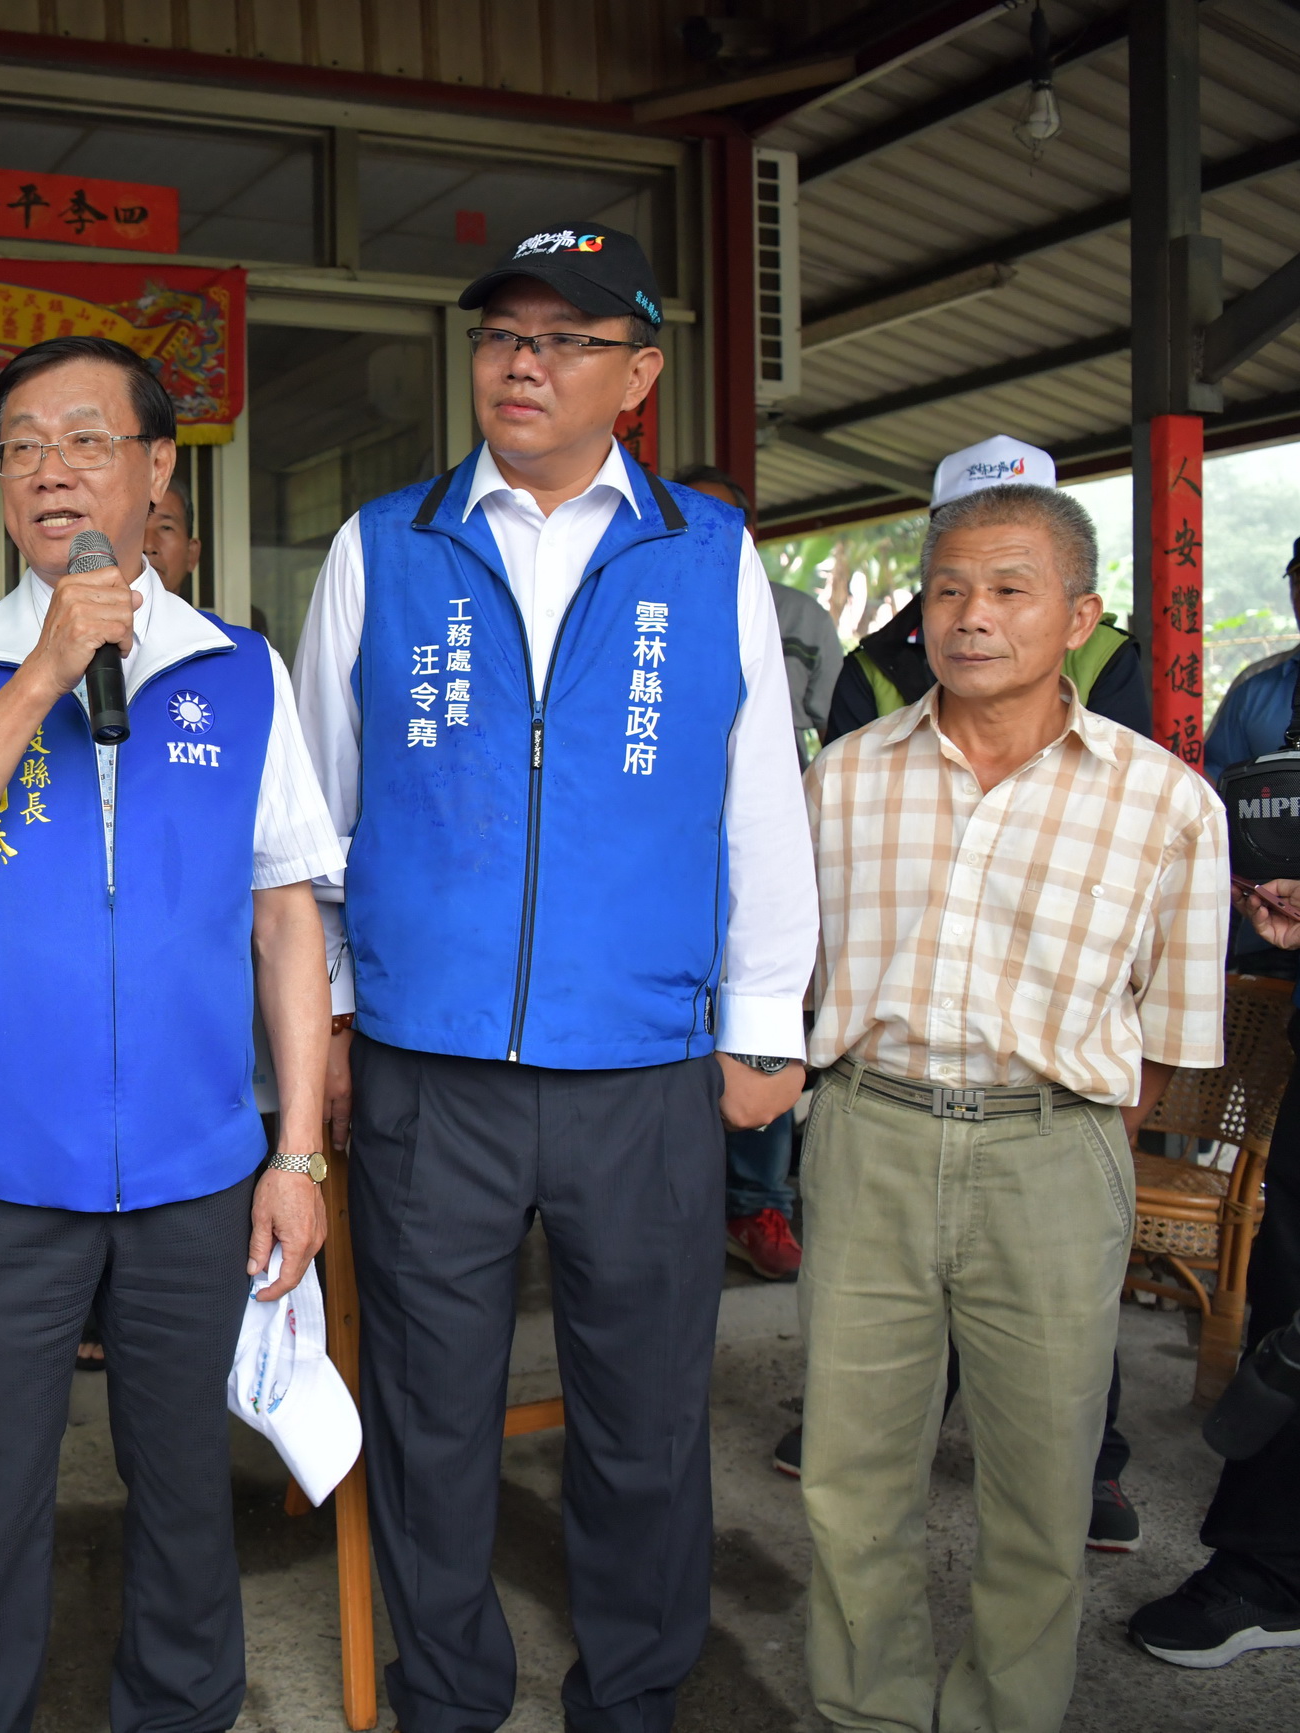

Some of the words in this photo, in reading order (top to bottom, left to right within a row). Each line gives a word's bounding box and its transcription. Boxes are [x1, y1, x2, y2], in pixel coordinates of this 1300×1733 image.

[1163, 456, 1203, 765] 人安體健福
[166, 741, 222, 768] KMT
[407, 645, 440, 748] 汪令堯
[623, 600, 669, 776] 雲林縣政府
